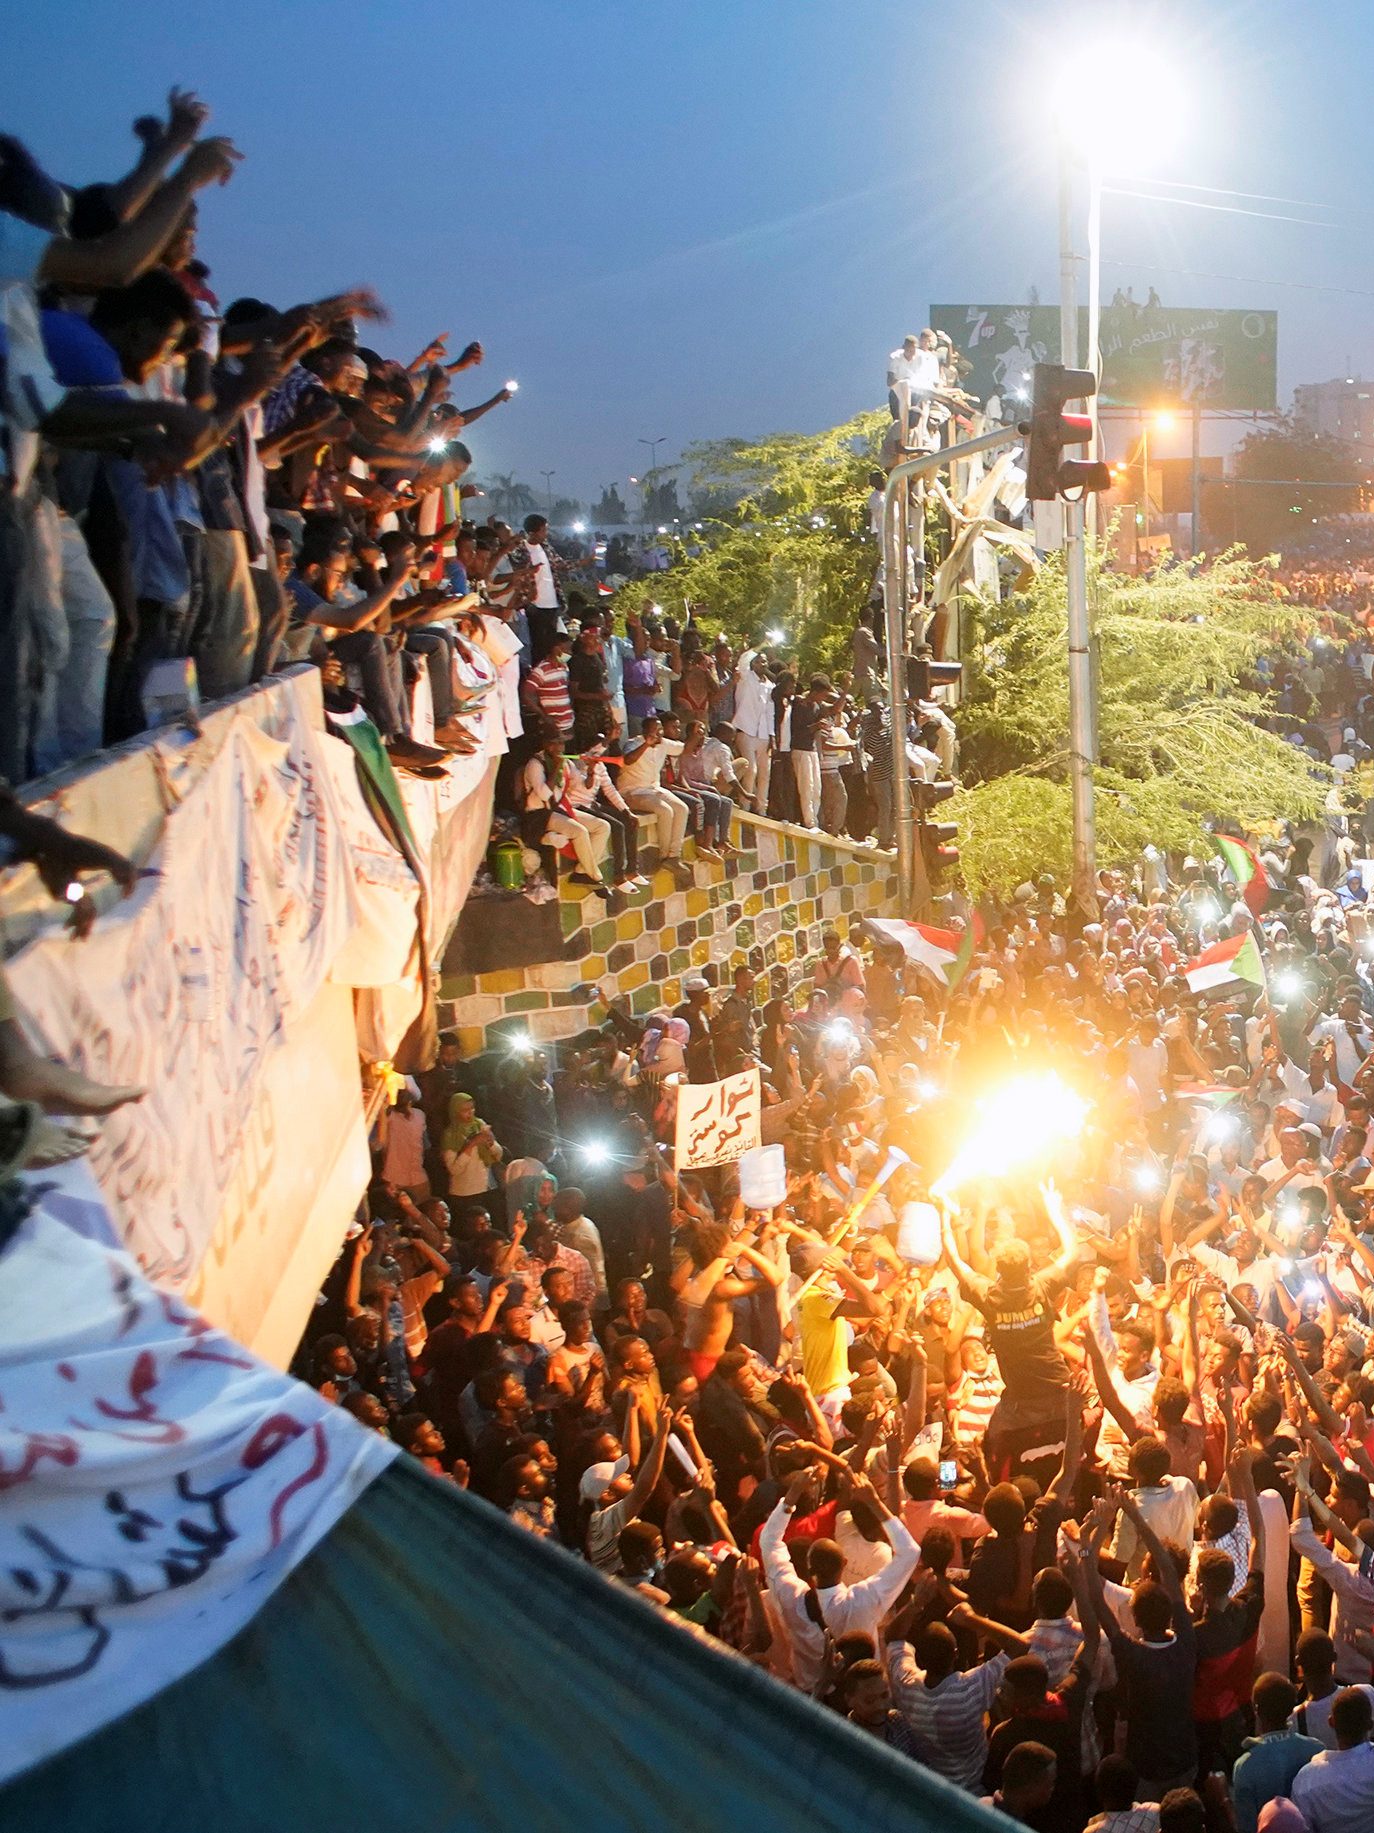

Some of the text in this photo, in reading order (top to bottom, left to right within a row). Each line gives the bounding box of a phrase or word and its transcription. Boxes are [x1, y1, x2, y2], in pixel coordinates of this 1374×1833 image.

[1128, 320, 1177, 356] الطعم
[1182, 318, 1219, 338] نفس
[690, 1077, 754, 1122] ثوار
[995, 1302, 1044, 1324] JUMBO
